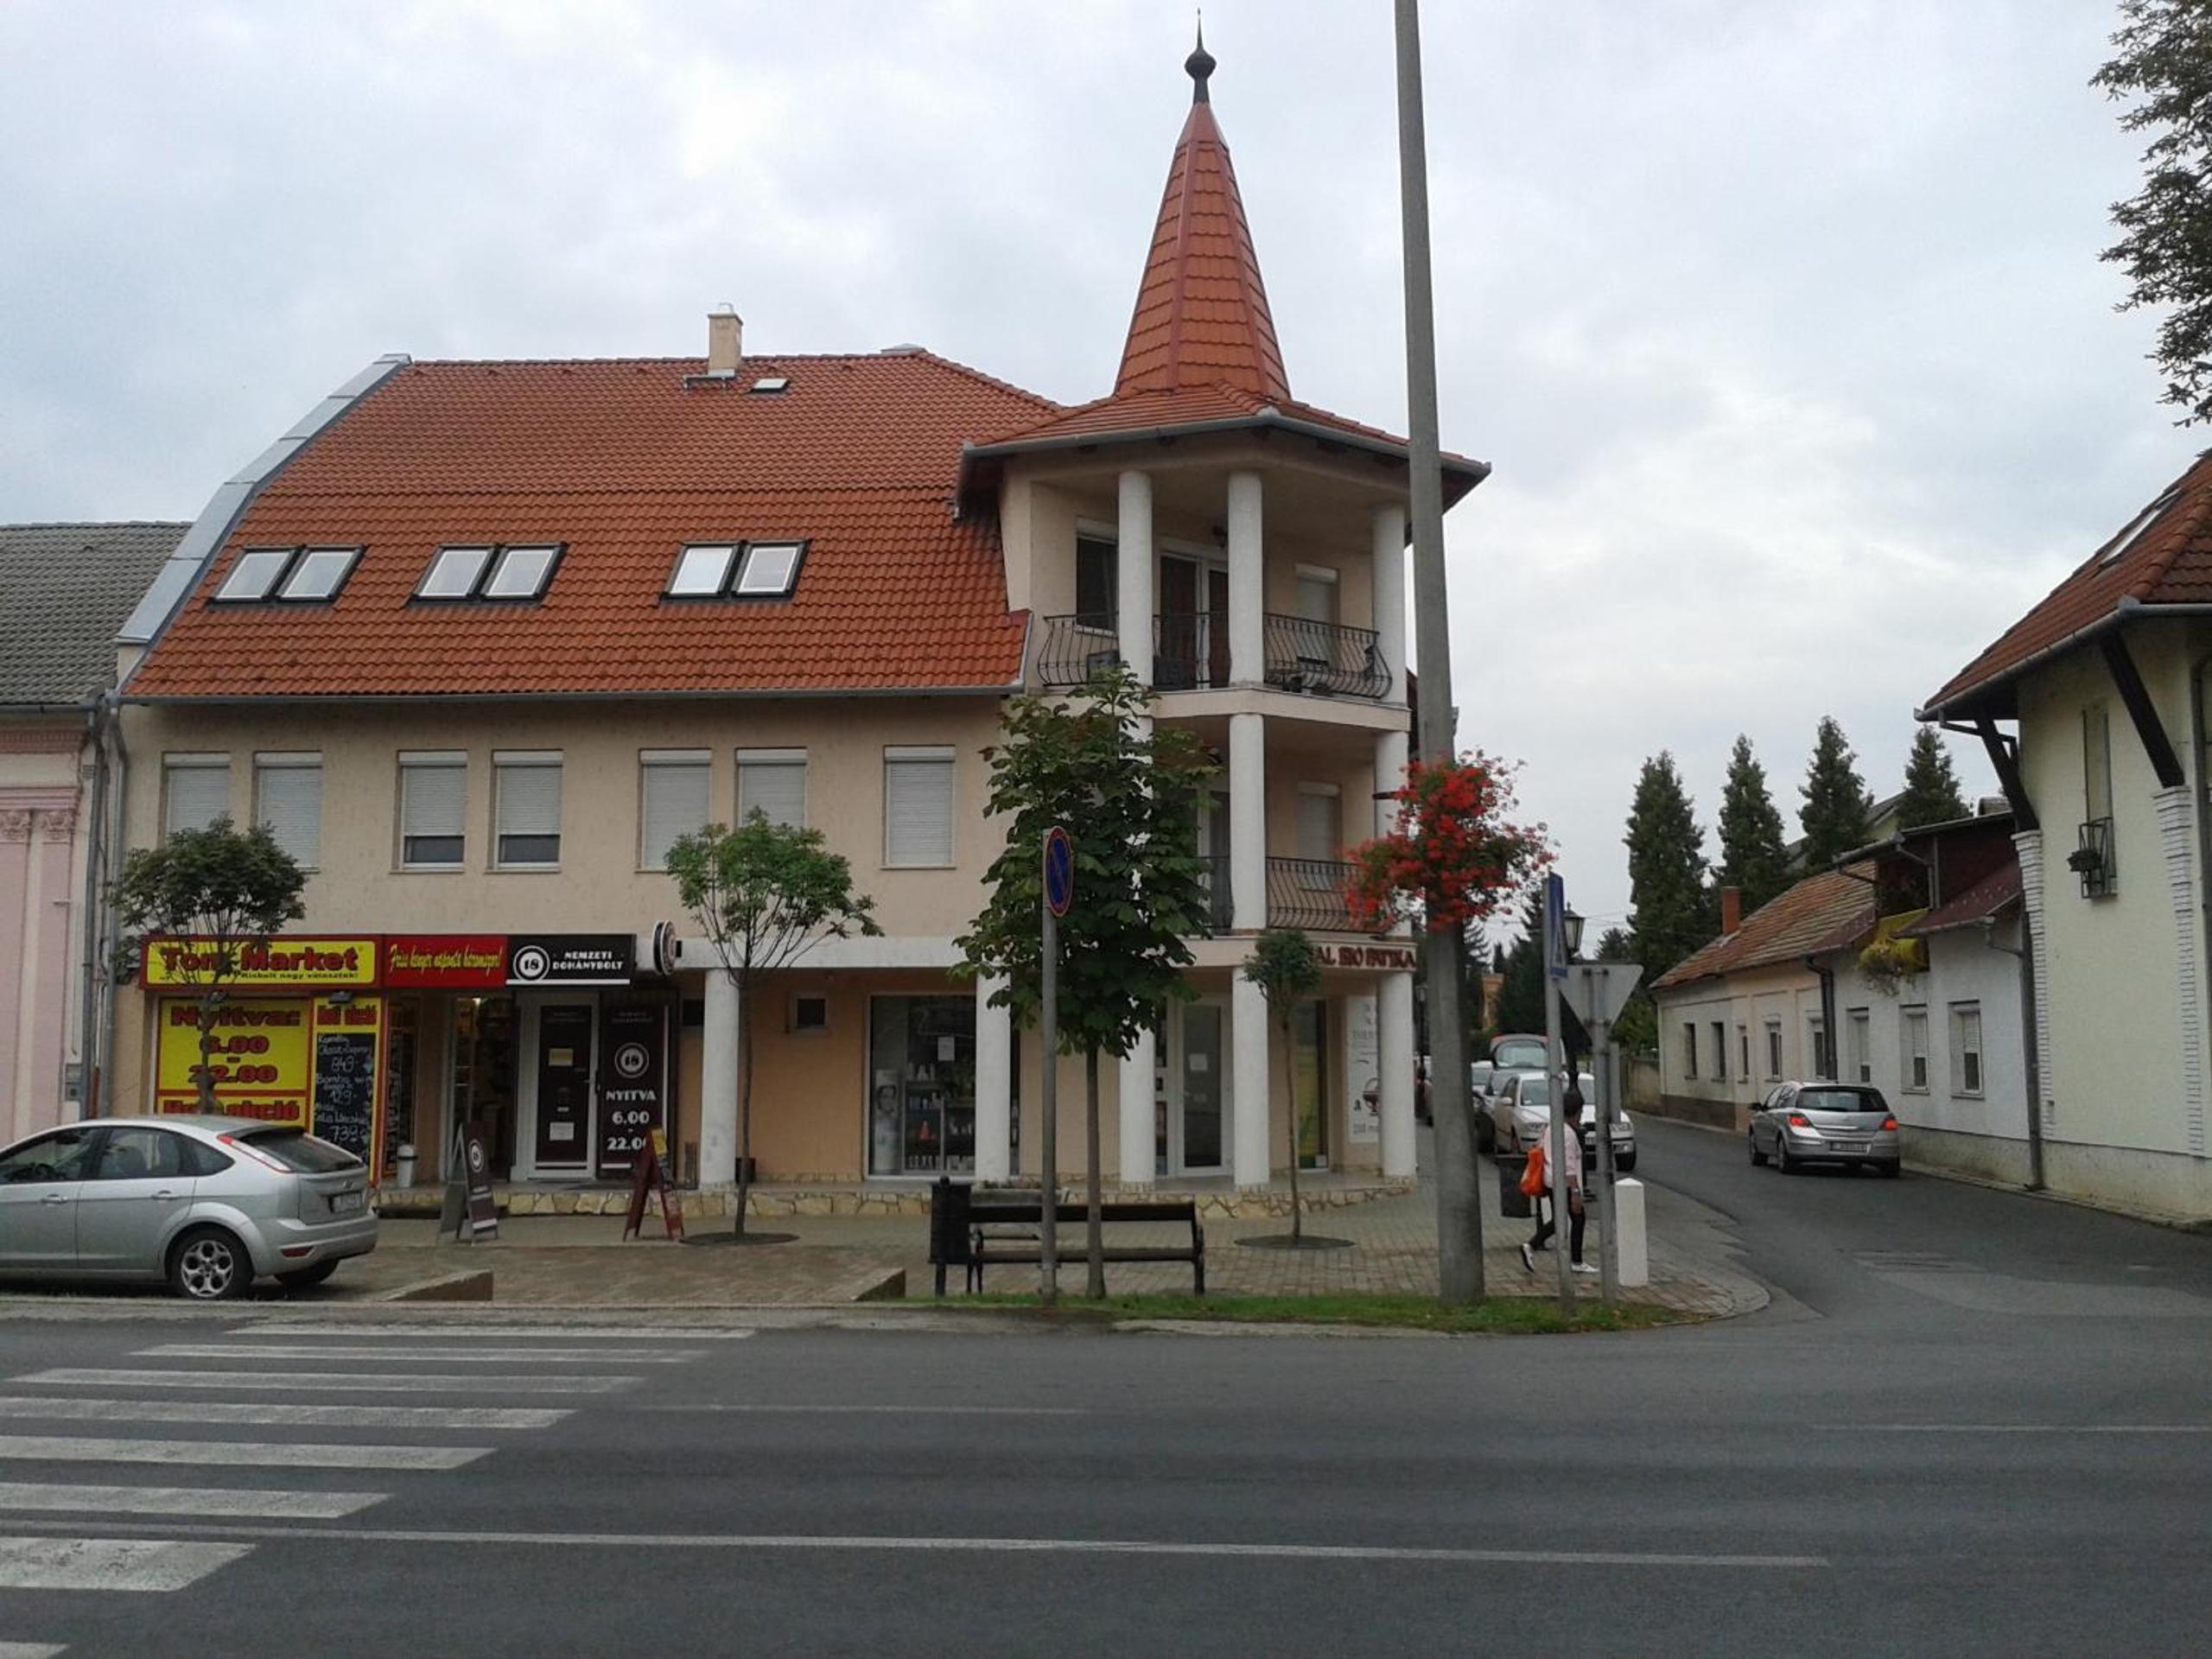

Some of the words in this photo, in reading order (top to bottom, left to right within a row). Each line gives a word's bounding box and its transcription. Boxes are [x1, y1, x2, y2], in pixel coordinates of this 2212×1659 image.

[241, 946, 359, 970] Market
[564, 950, 613, 960] NEMZETI
[524, 958, 539, 970] 18
[552, 960, 623, 969] DOHÁNYBOLT
[171, 1006, 302, 1031] Nyitva:
[188, 1065, 278, 1084] 22.00
[606, 1090, 657, 1102] NYITVA
[612, 1110, 650, 1124] 6.00
